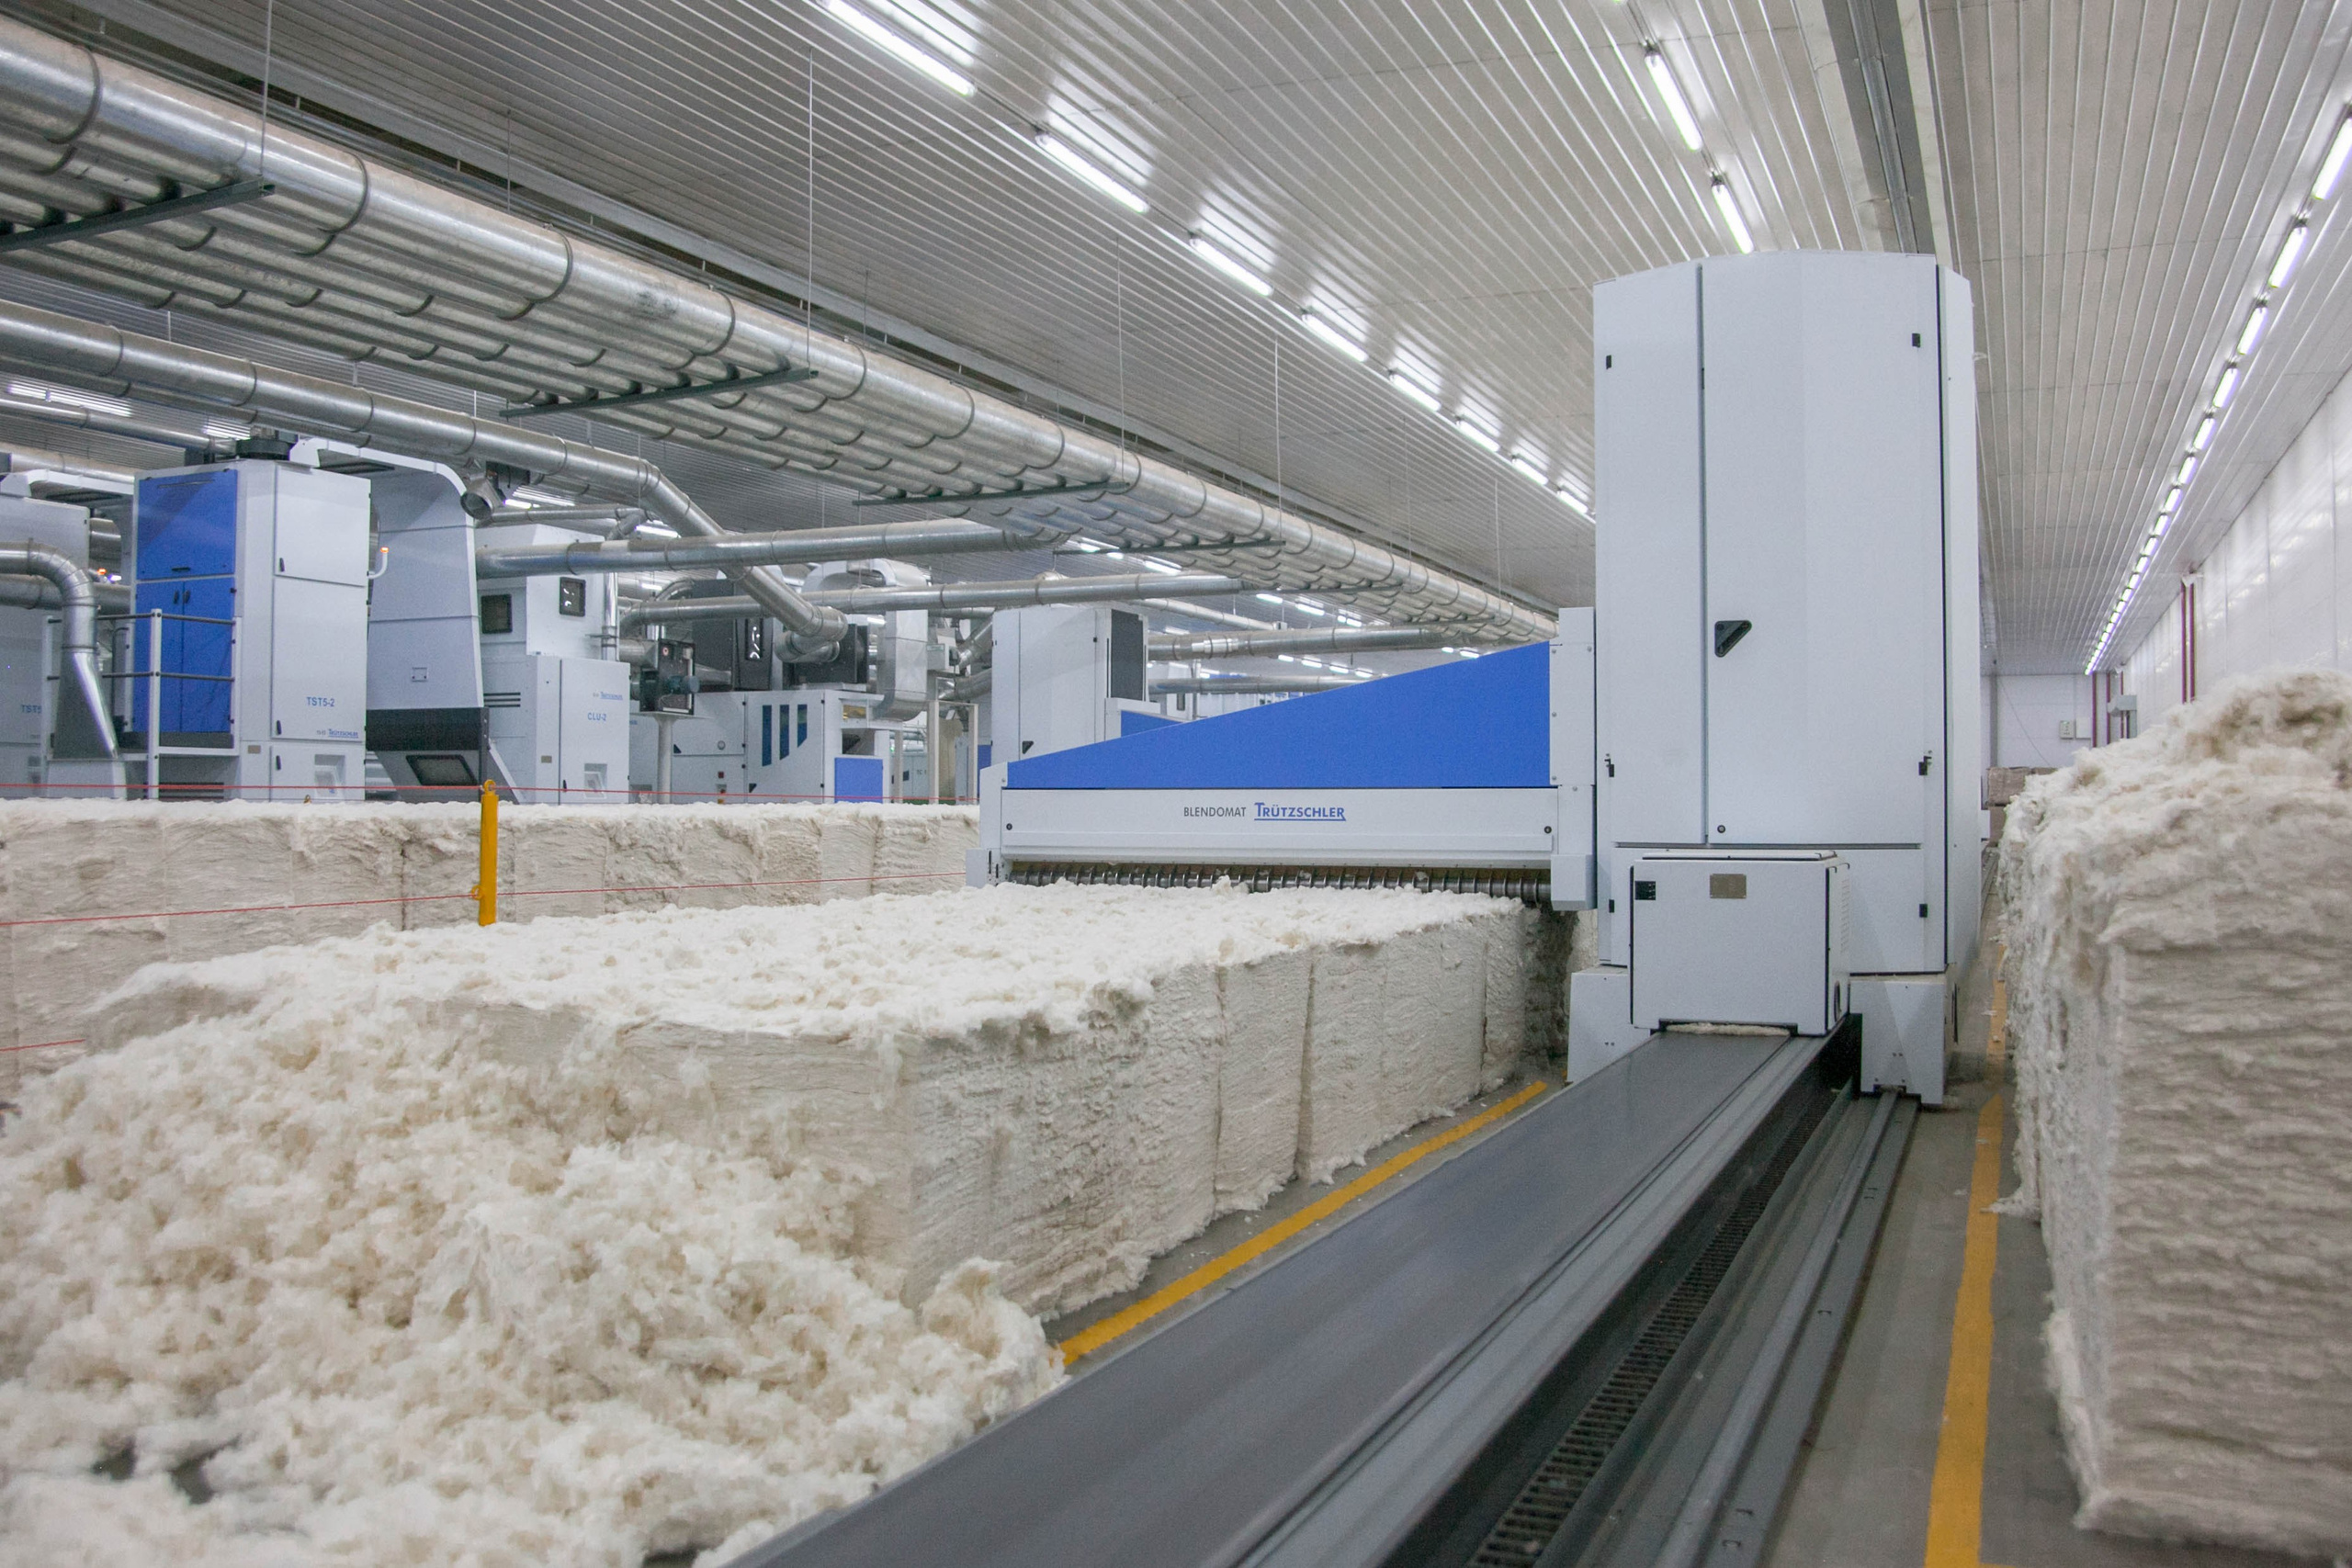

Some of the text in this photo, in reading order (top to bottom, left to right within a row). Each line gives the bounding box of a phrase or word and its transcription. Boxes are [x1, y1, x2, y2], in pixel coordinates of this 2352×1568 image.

[306, 696, 335, 707] TST5-2
[1183, 802, 1347, 821] BLENDOMAT TRÜTZSCHLER
